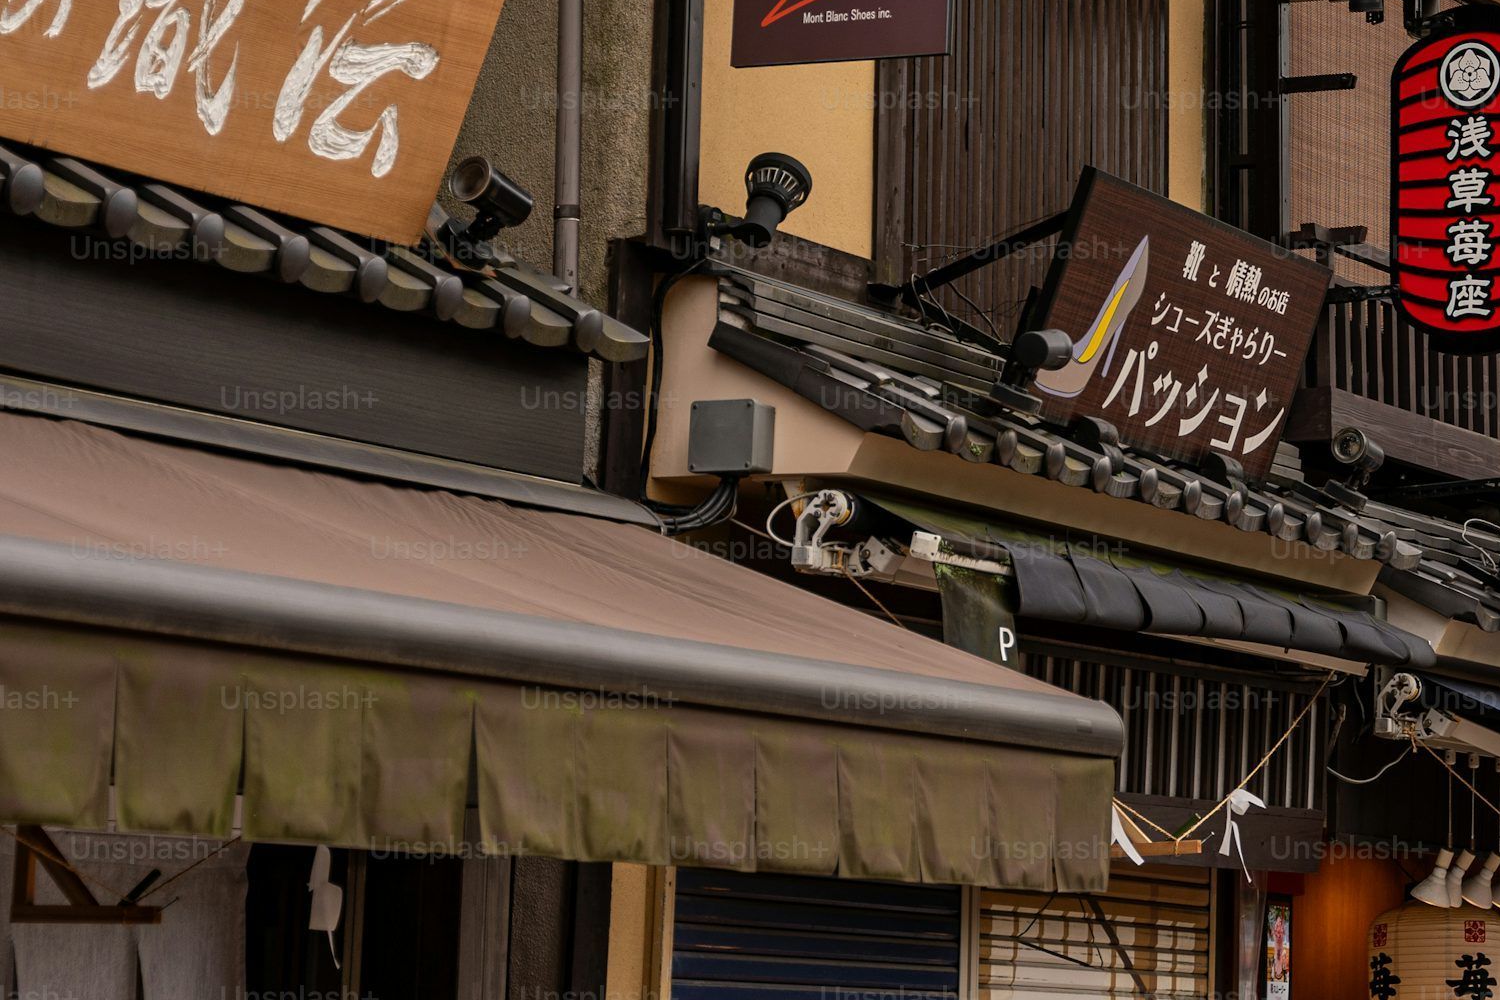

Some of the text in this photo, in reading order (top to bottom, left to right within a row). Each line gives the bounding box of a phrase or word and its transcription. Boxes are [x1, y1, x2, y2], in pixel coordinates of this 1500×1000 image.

[803, 7, 892, 24] Mont Blanc Shoes inc.
[1446, 115, 1492, 319] 浅草苺座
[1101, 340, 1285, 455] パッション
